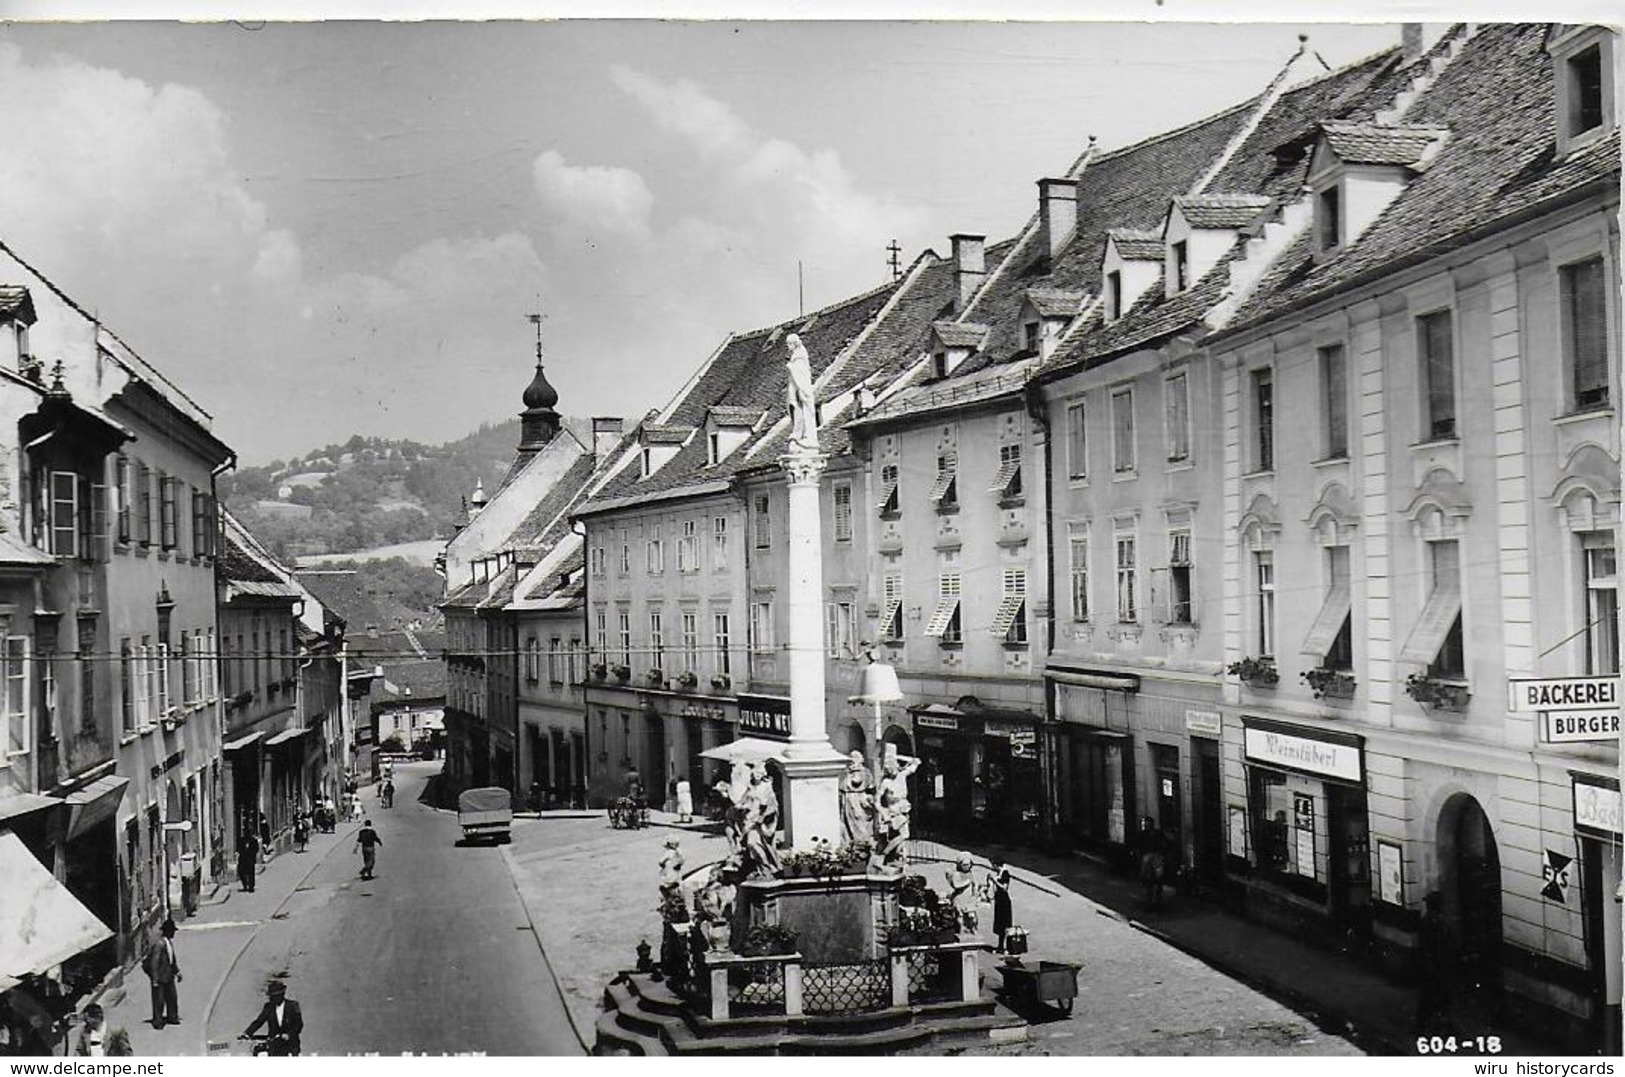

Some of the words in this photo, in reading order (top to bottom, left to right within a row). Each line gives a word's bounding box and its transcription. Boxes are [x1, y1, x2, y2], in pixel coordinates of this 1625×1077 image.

[1528, 683, 1616, 705] BÄCKEREI
[739, 710, 771, 729] JULIUS
[1555, 716, 1620, 735] BÜRGER
